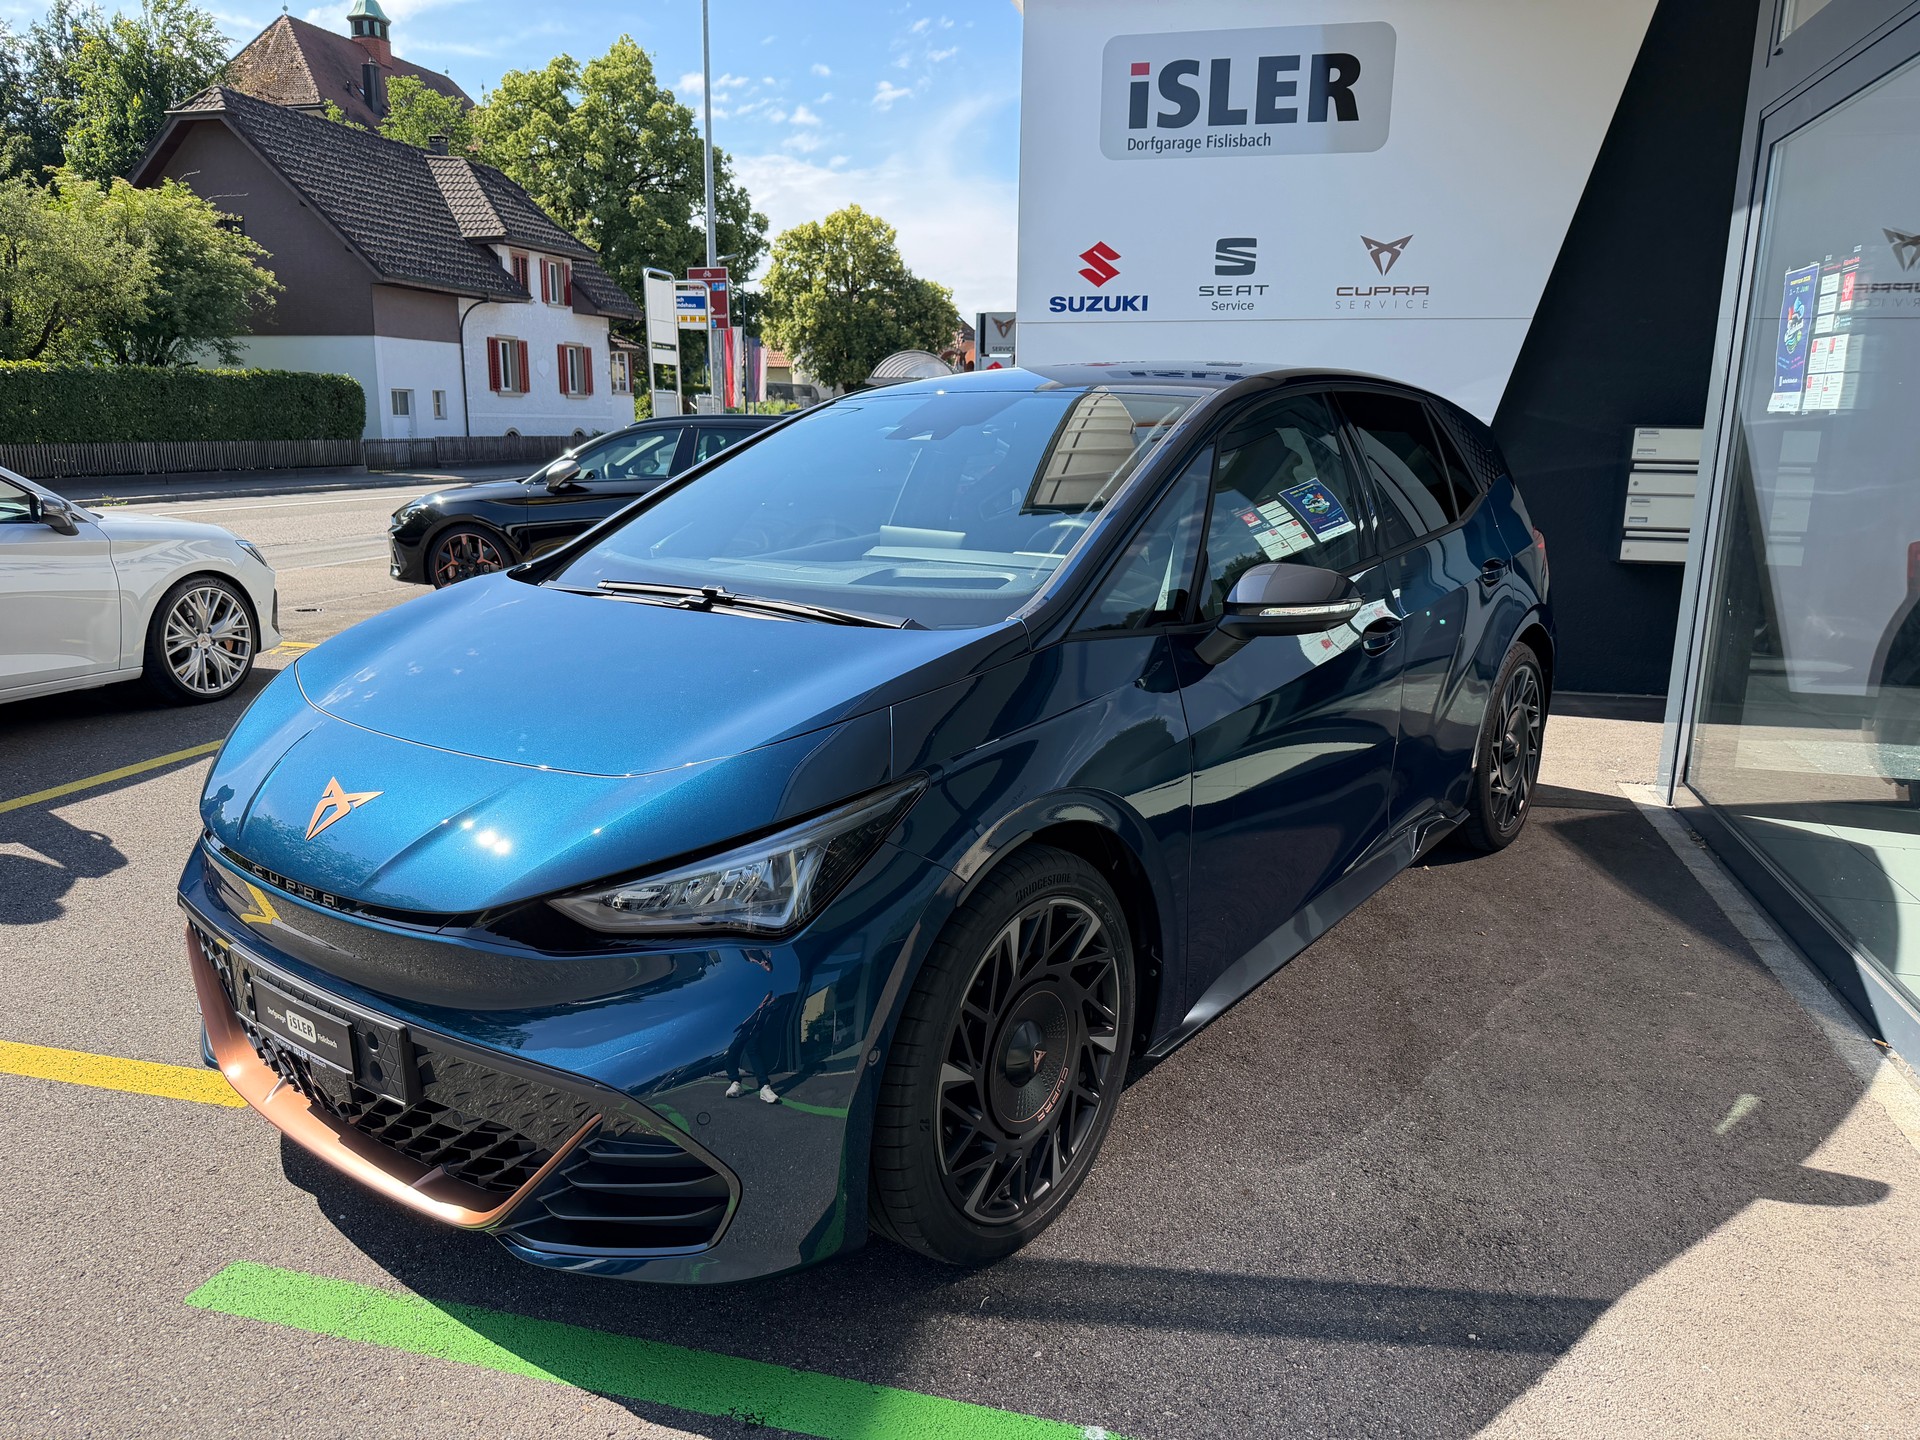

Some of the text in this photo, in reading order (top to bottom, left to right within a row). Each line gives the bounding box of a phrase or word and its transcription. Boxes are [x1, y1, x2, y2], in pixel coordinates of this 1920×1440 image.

[1129, 53, 1361, 129] iSLER
[1127, 132, 1272, 153] Dorfgarage Fislisbach
[1199, 285, 1269, 297] SEAT
[1336, 286, 1429, 296] CUPRA
[1049, 295, 1148, 312] SUZUKI
[1211, 300, 1254, 311] Service
[1335, 300, 1429, 310] SERVICE
[253, 865, 334, 906] CUPRA
[1015, 873, 1071, 903] BRIDGESTONE
[289, 1015, 314, 1038] iSLER
[1037, 1067, 1069, 1122] CUPRA
